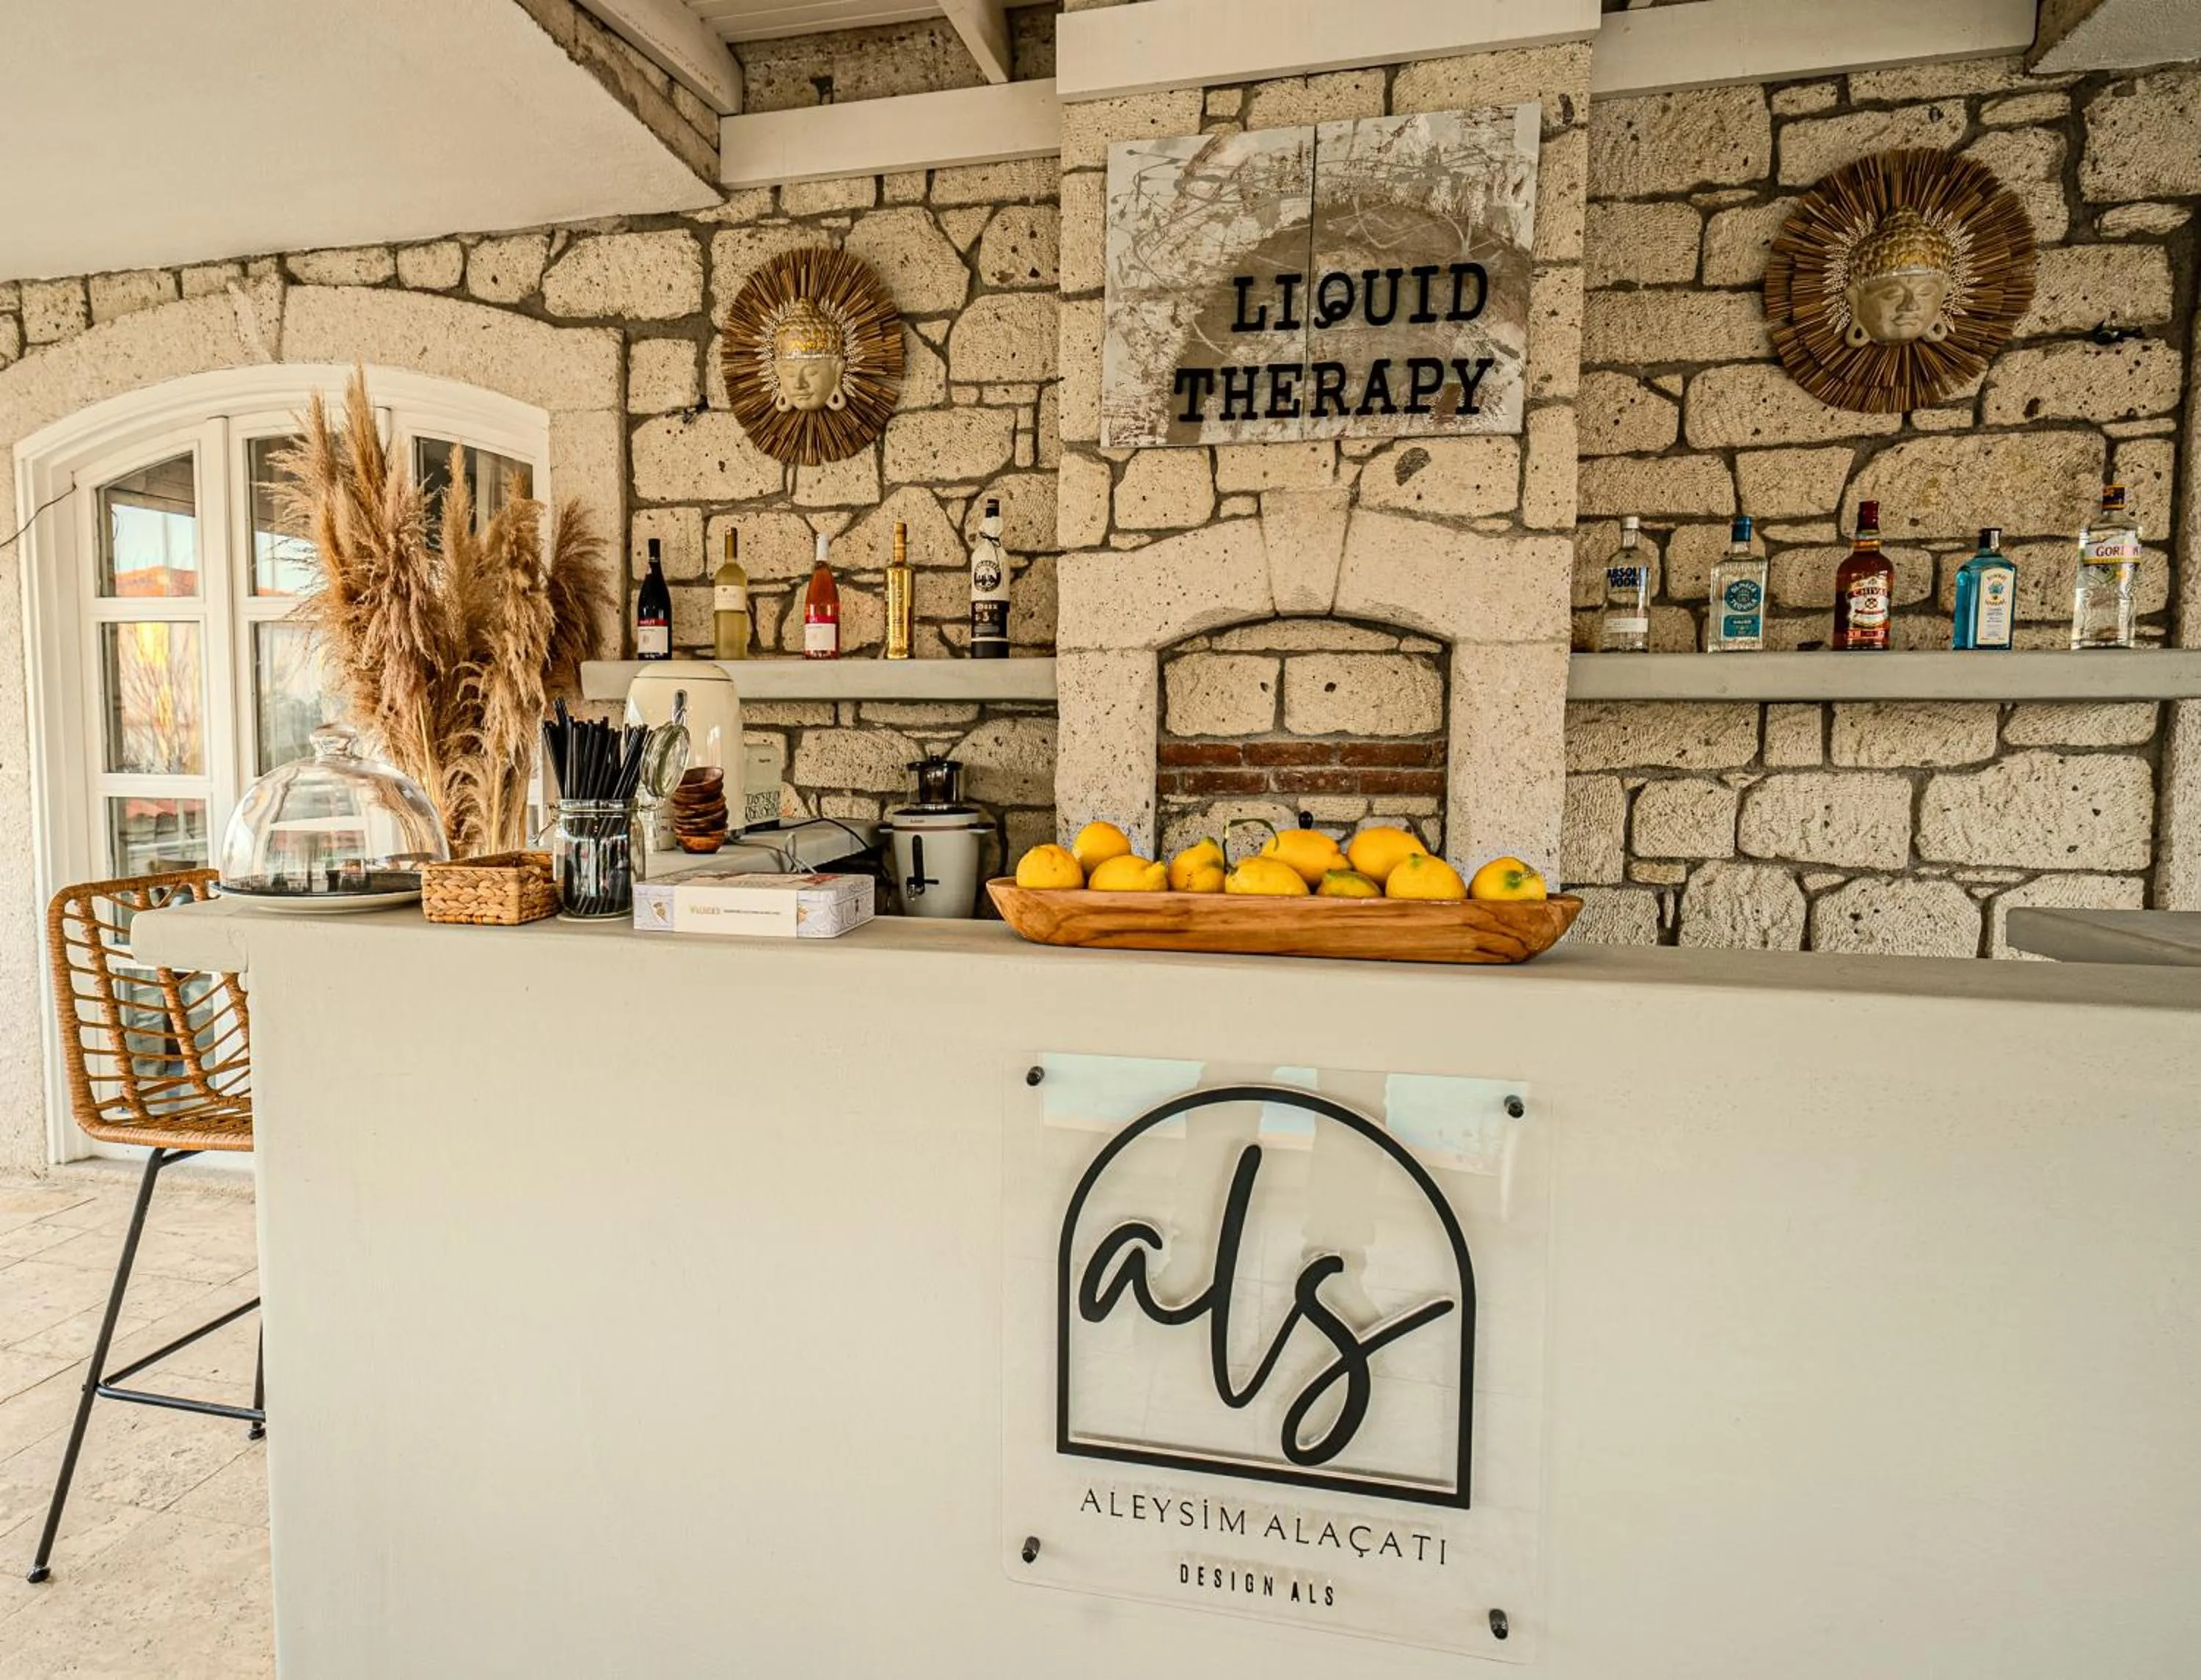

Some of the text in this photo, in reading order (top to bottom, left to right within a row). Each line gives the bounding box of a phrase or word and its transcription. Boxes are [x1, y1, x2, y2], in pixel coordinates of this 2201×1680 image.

[1230, 262, 1489, 333] LIQUID
[1174, 357, 1494, 423] THERAPY
[2096, 545, 2139, 557] GORN
[1078, 1143, 1455, 1467] als
[1080, 1487, 1447, 1565] ALEYSİM ALAÇATI
[1180, 1563, 1335, 1607] DESIGN ALS
